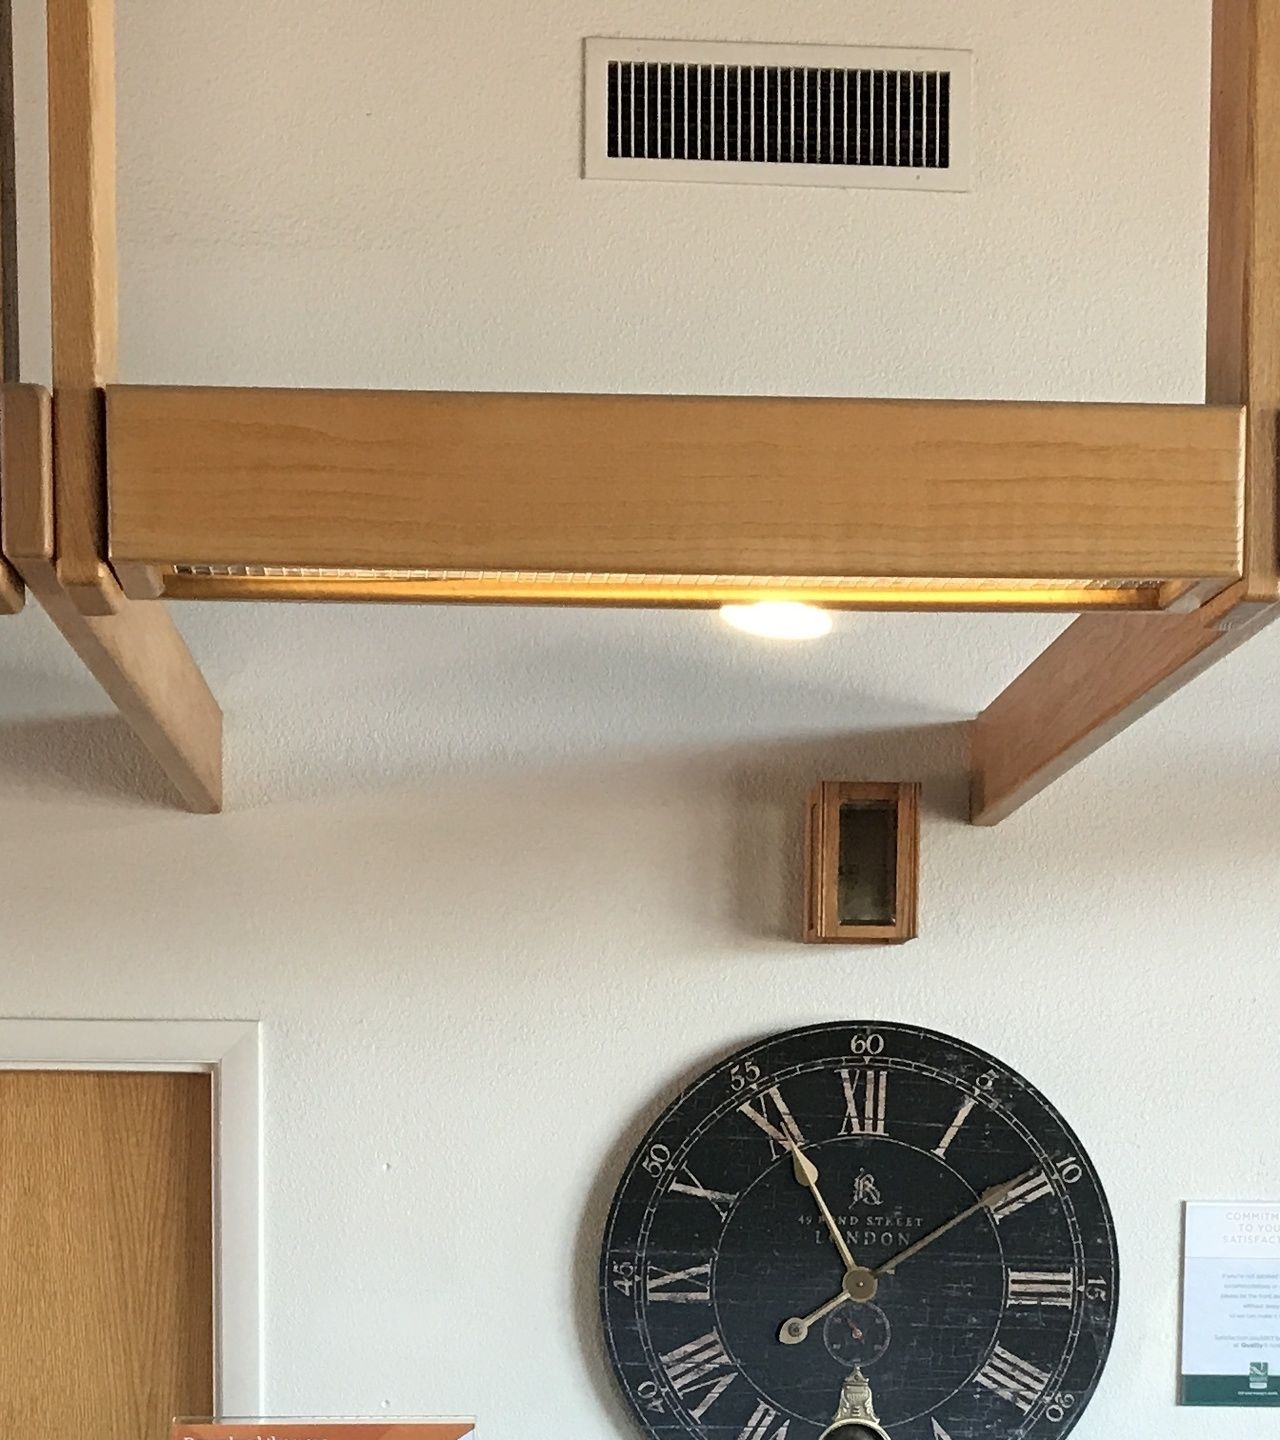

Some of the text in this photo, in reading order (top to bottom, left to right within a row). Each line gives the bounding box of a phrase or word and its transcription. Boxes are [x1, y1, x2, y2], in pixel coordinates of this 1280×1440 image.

[851, 1034, 884, 1055] 60
[729, 1061, 760, 1091] 55
[834, 1069, 889, 1136] XII
[736, 1084, 808, 1162] XI
[931, 1095, 978, 1160] I
[642, 1144, 670, 1178] 50
[1056, 1156, 1082, 1184] 10
[668, 1161, 740, 1223] X
[798, 1215, 811, 1225] 49
[866, 1216, 924, 1227] STREET
[815, 1230, 910, 1246] LNDON
[1240, 1223, 1253, 1232] TO
[612, 1261, 634, 1296] 45
[646, 1258, 713, 1306] IX
[1006, 1267, 1073, 1310] III
[1085, 1276, 1107, 1301] 15
[659, 1326, 738, 1424] VIII
[973, 1340, 1052, 1416] IIII
[637, 1381, 665, 1414] 40
[1046, 1392, 1074, 1422] 20
